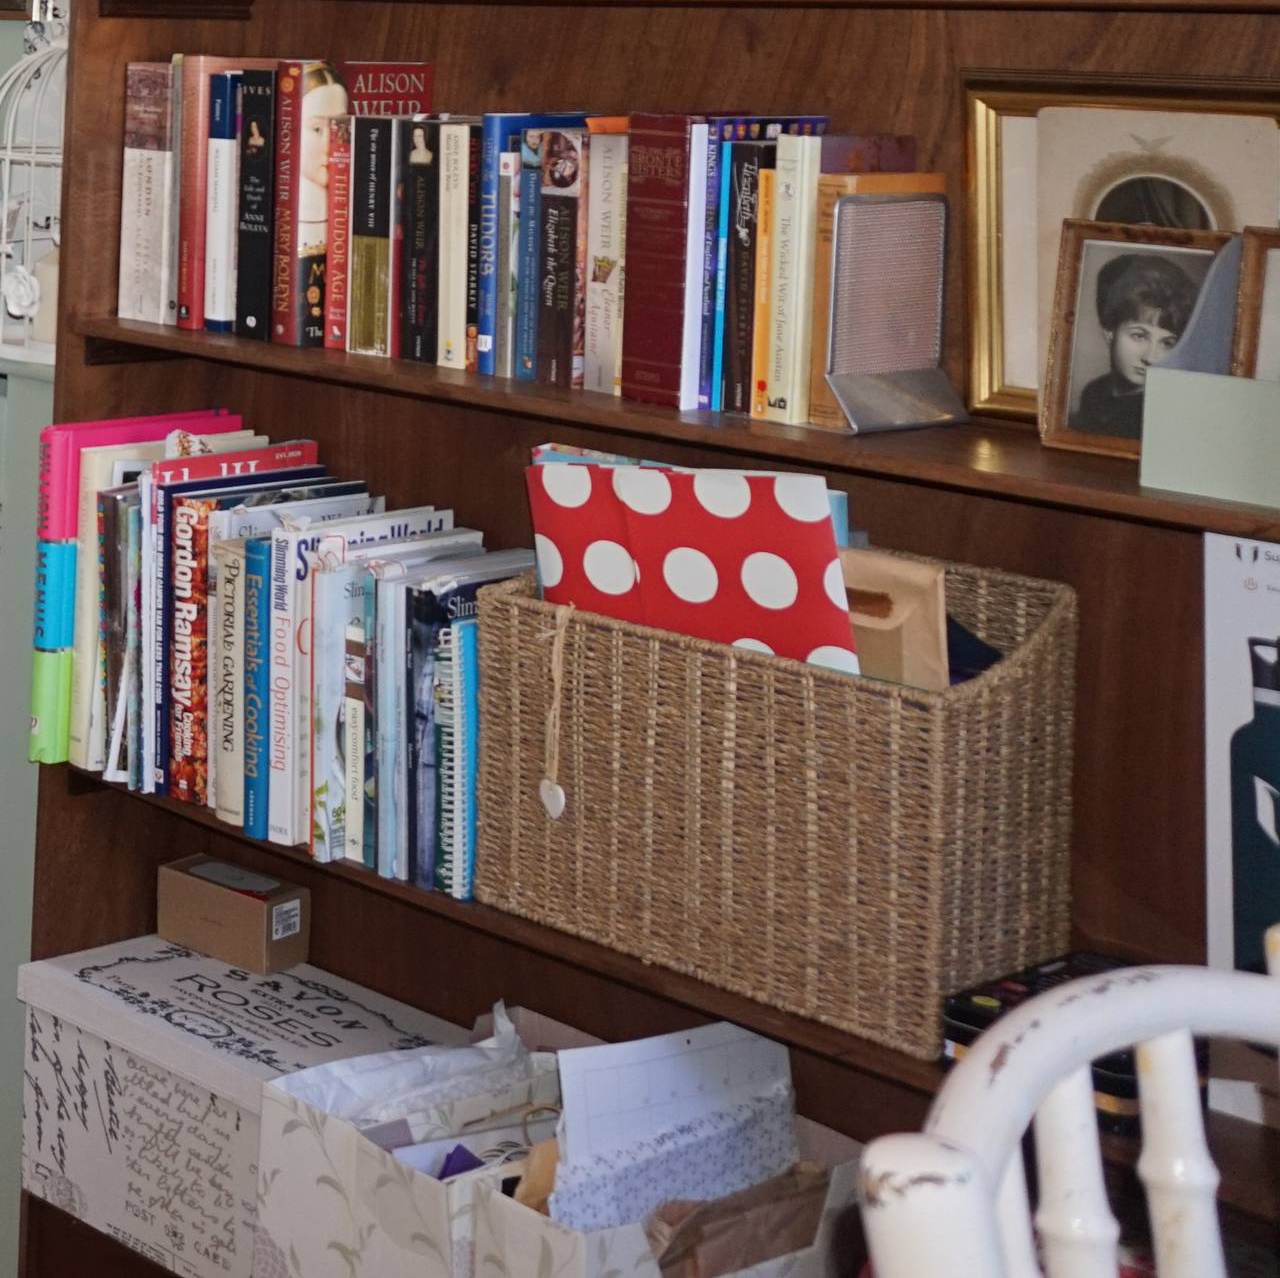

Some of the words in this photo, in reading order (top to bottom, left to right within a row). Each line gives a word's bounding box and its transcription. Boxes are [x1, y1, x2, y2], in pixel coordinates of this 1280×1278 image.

[241, 85, 272, 97] IVES
[352, 73, 425, 93] ALISON
[279, 95, 292, 155] ALISON
[601, 145, 614, 203] ALISON
[706, 143, 718, 178] KINGS
[278, 159, 292, 202] WEIR
[334, 173, 348, 203] THE
[367, 181, 377, 210] HENRY
[415, 175, 426, 218] ALISON
[243, 212, 265, 223] ANNE
[278, 208, 292, 251] MARY
[332, 206, 348, 265] TUDOR
[366, 212, 376, 229] VIII
[415, 219, 426, 250] WEIR
[480, 189, 497, 276] TUDORS
[545, 207, 559, 254] Elizabeth
[558, 205, 571, 266] ALISON
[600, 210, 612, 250] WEIR
[780, 216, 792, 236] The
[469, 223, 479, 259] DAVID
[778, 239, 792, 280] Wicked
[546, 257, 557, 273] the
[331, 269, 347, 301] AGE
[468, 262, 478, 309] STARKEY
[544, 274, 557, 307] Queen
[557, 271, 570, 310] WEIR
[778, 281, 790, 303] Wit
[774, 318, 788, 342] Jane
[777, 305, 790, 317] of
[773, 345, 786, 382] Austen
[173, 505, 199, 597] Gordon
[272, 537, 290, 584] Slimming
[222, 558, 241, 652] PICTORIAL
[273, 584, 289, 611] World
[155, 626, 164, 641] FOR
[156, 609, 164, 625] VAN
[245, 572, 264, 672] Essentials
[155, 642, 164, 661] LESS
[171, 601, 198, 704] Ramsay
[273, 615, 292, 667] Food
[155, 661, 164, 682] THAN
[247, 674, 259, 690] of
[174, 702, 184, 717] for
[217, 656, 237, 753] GARDENING
[270, 675, 292, 772] Optimising
[350, 707, 360, 729] easy
[173, 719, 185, 762] Friends
[181, 711, 195, 756] Cooking
[243, 692, 264, 779] Cooking
[350, 730, 361, 773] comfort
[350, 774, 361, 801] food
[176, 972, 343, 1050] ROSES
